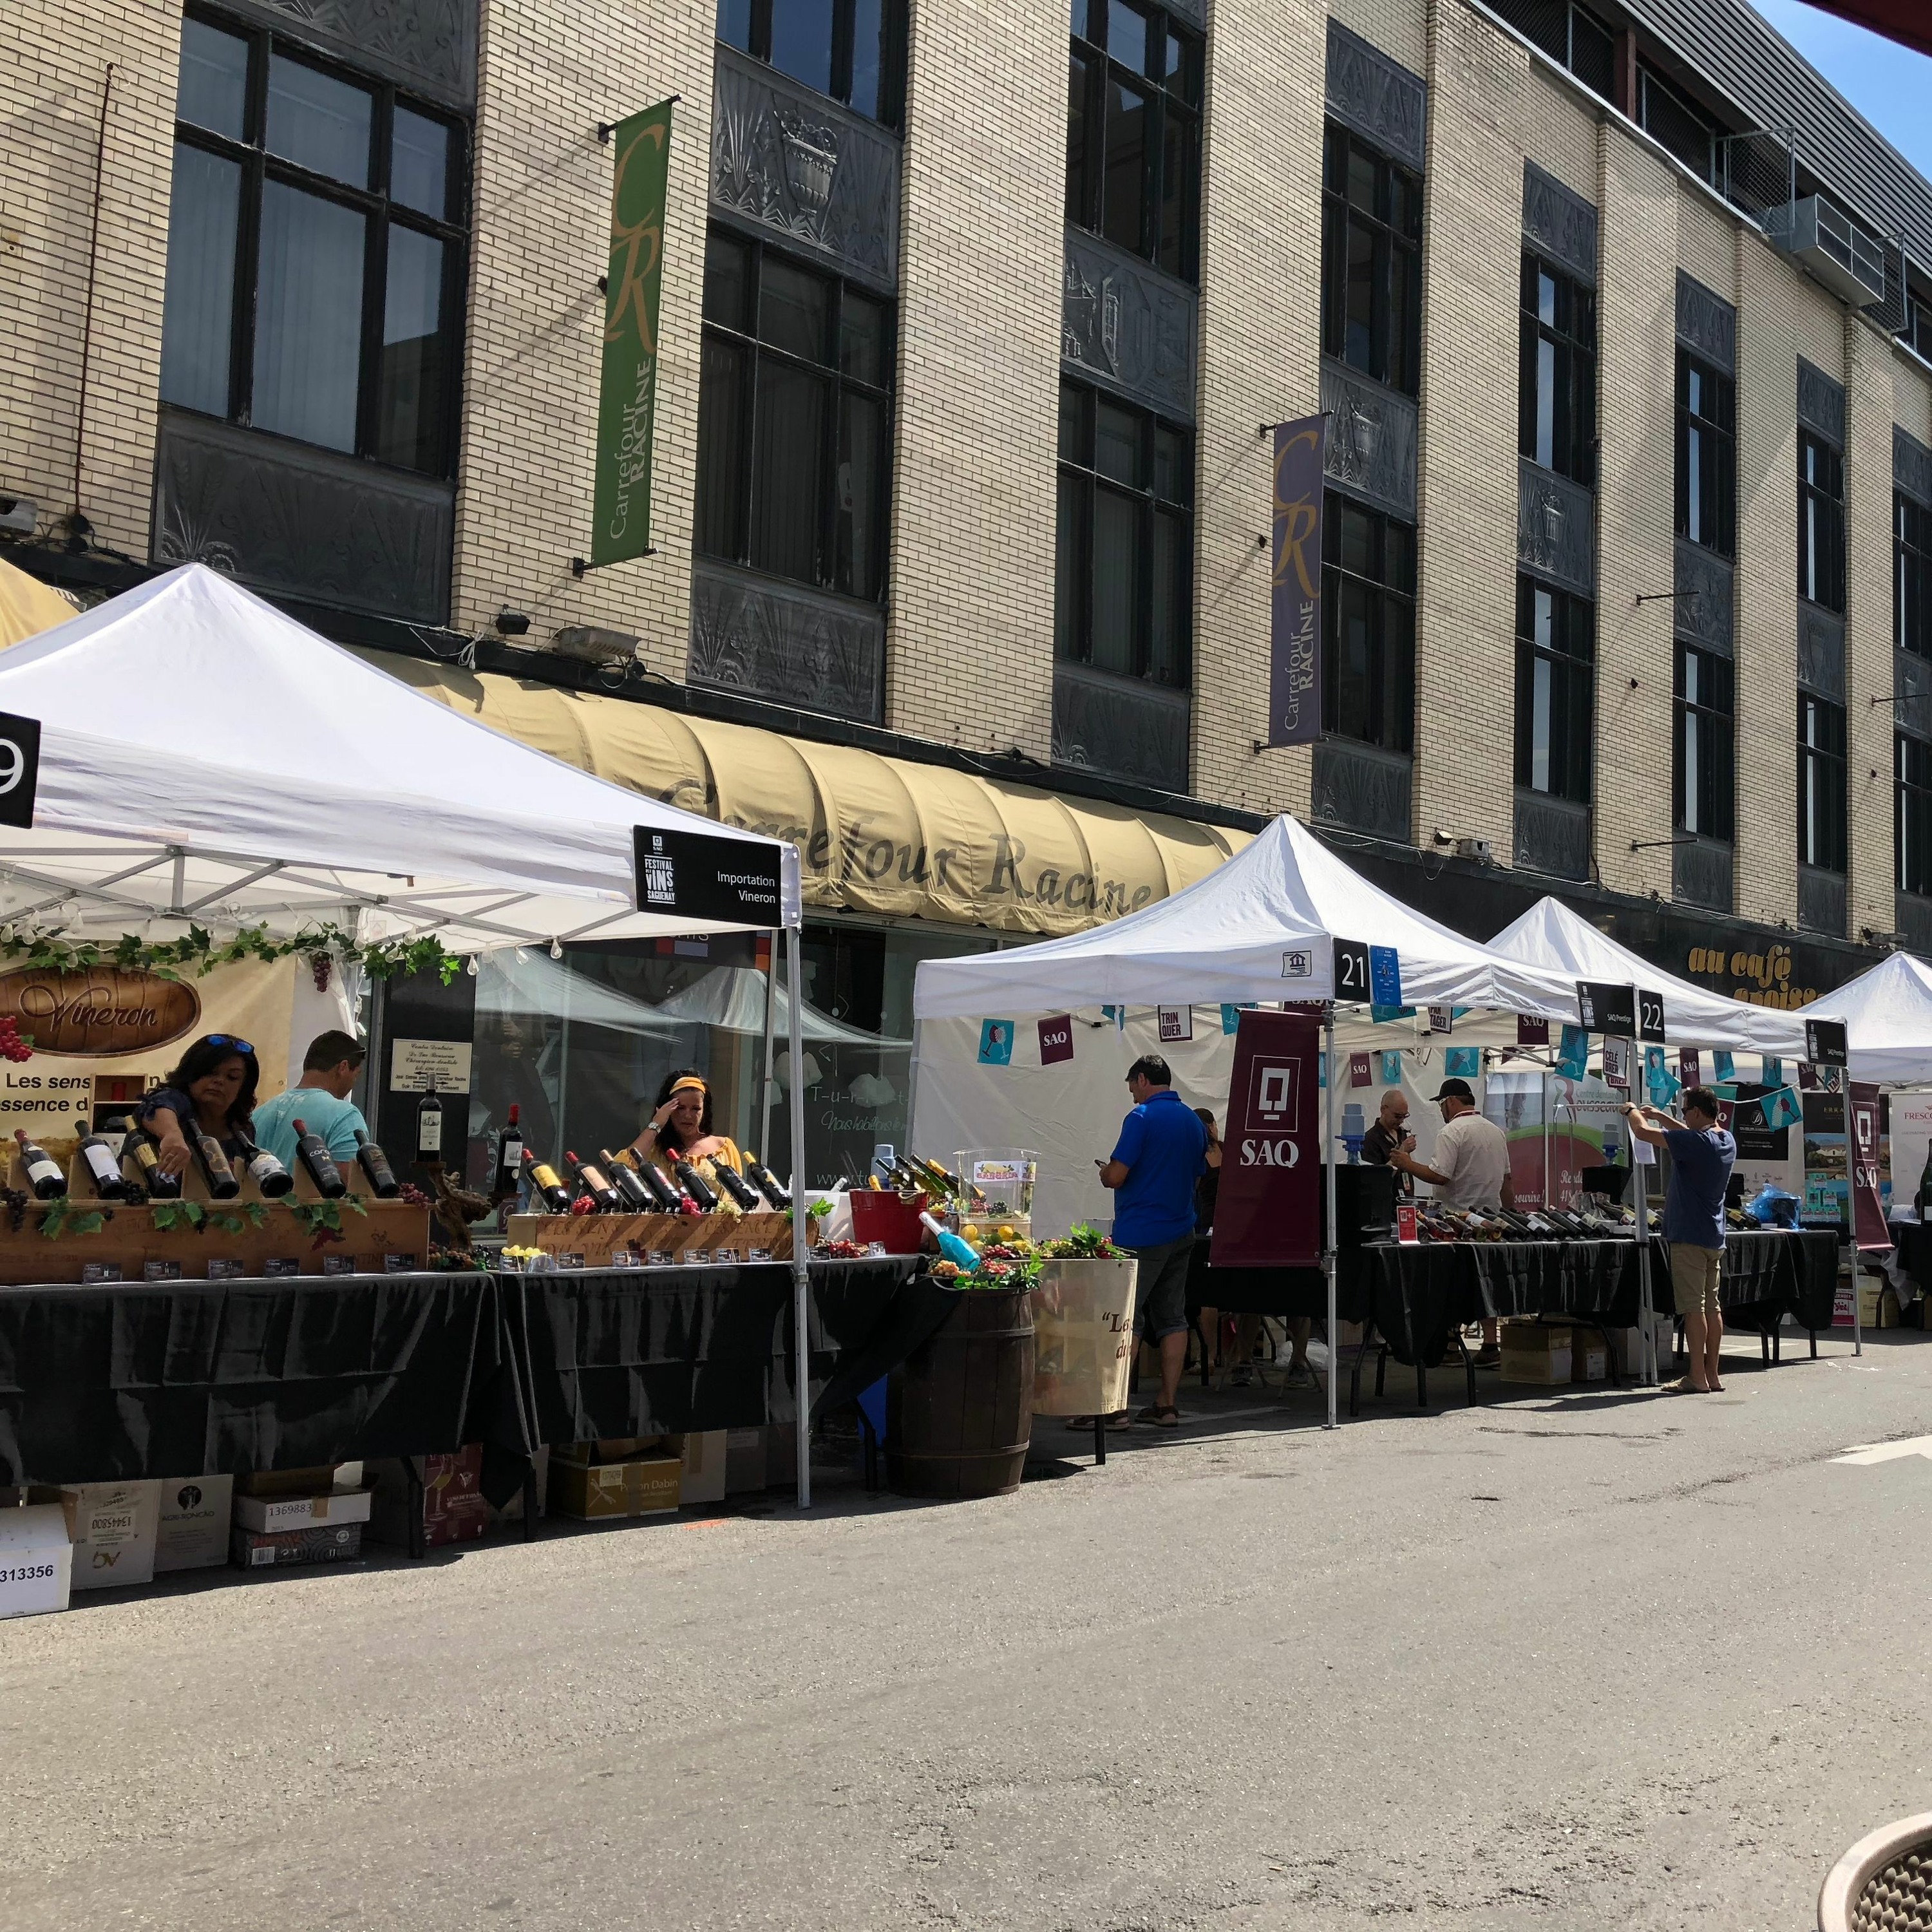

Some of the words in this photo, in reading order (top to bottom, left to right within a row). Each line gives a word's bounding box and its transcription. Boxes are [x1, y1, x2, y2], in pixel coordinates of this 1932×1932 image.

[629, 357, 652, 484] RACINE
[609, 403, 636, 540] Carrefour
[1298, 600, 1314, 690] RACINE
[1283, 632, 1301, 731] Carrefour
[645, 858, 674, 871] FESTIVAL
[646, 869, 674, 891] VINS
[717, 871, 775, 887] Importation
[974, 833, 1151, 916] Racine
[647, 890, 676, 902] SAGUENAY
[738, 889, 776, 904] Vineron
[1341, 953, 1365, 988] 21
[1688, 947, 1725, 974] au
[1730, 944, 1792, 989] café
[19, 985, 158, 1032] Vineron
[1643, 1002, 1662, 1030] 22
[1161, 1011, 1179, 1025] TRIN
[1430, 1014, 1446, 1028] TAGER
[1523, 1015, 1544, 1027] SAQ
[1607, 1013, 1616, 1022] SAQ
[1616, 1014, 1632, 1023] Prestige
[1162, 1023, 1181, 1037] QUER
[1043, 1031, 1067, 1046] SAQ
[1352, 1065, 1367, 1074] SAQ
[1683, 1061, 1697, 1072] SAQ
[6, 1073, 42, 1089] Les
[48, 1075, 91, 1089] sens
[1239, 1139, 1300, 1168] SAQ
[1514, 1189, 1545, 1203] sourire!
[651, 1478, 679, 1490] Dabin
[0, 1564, 54, 1583] 313356
